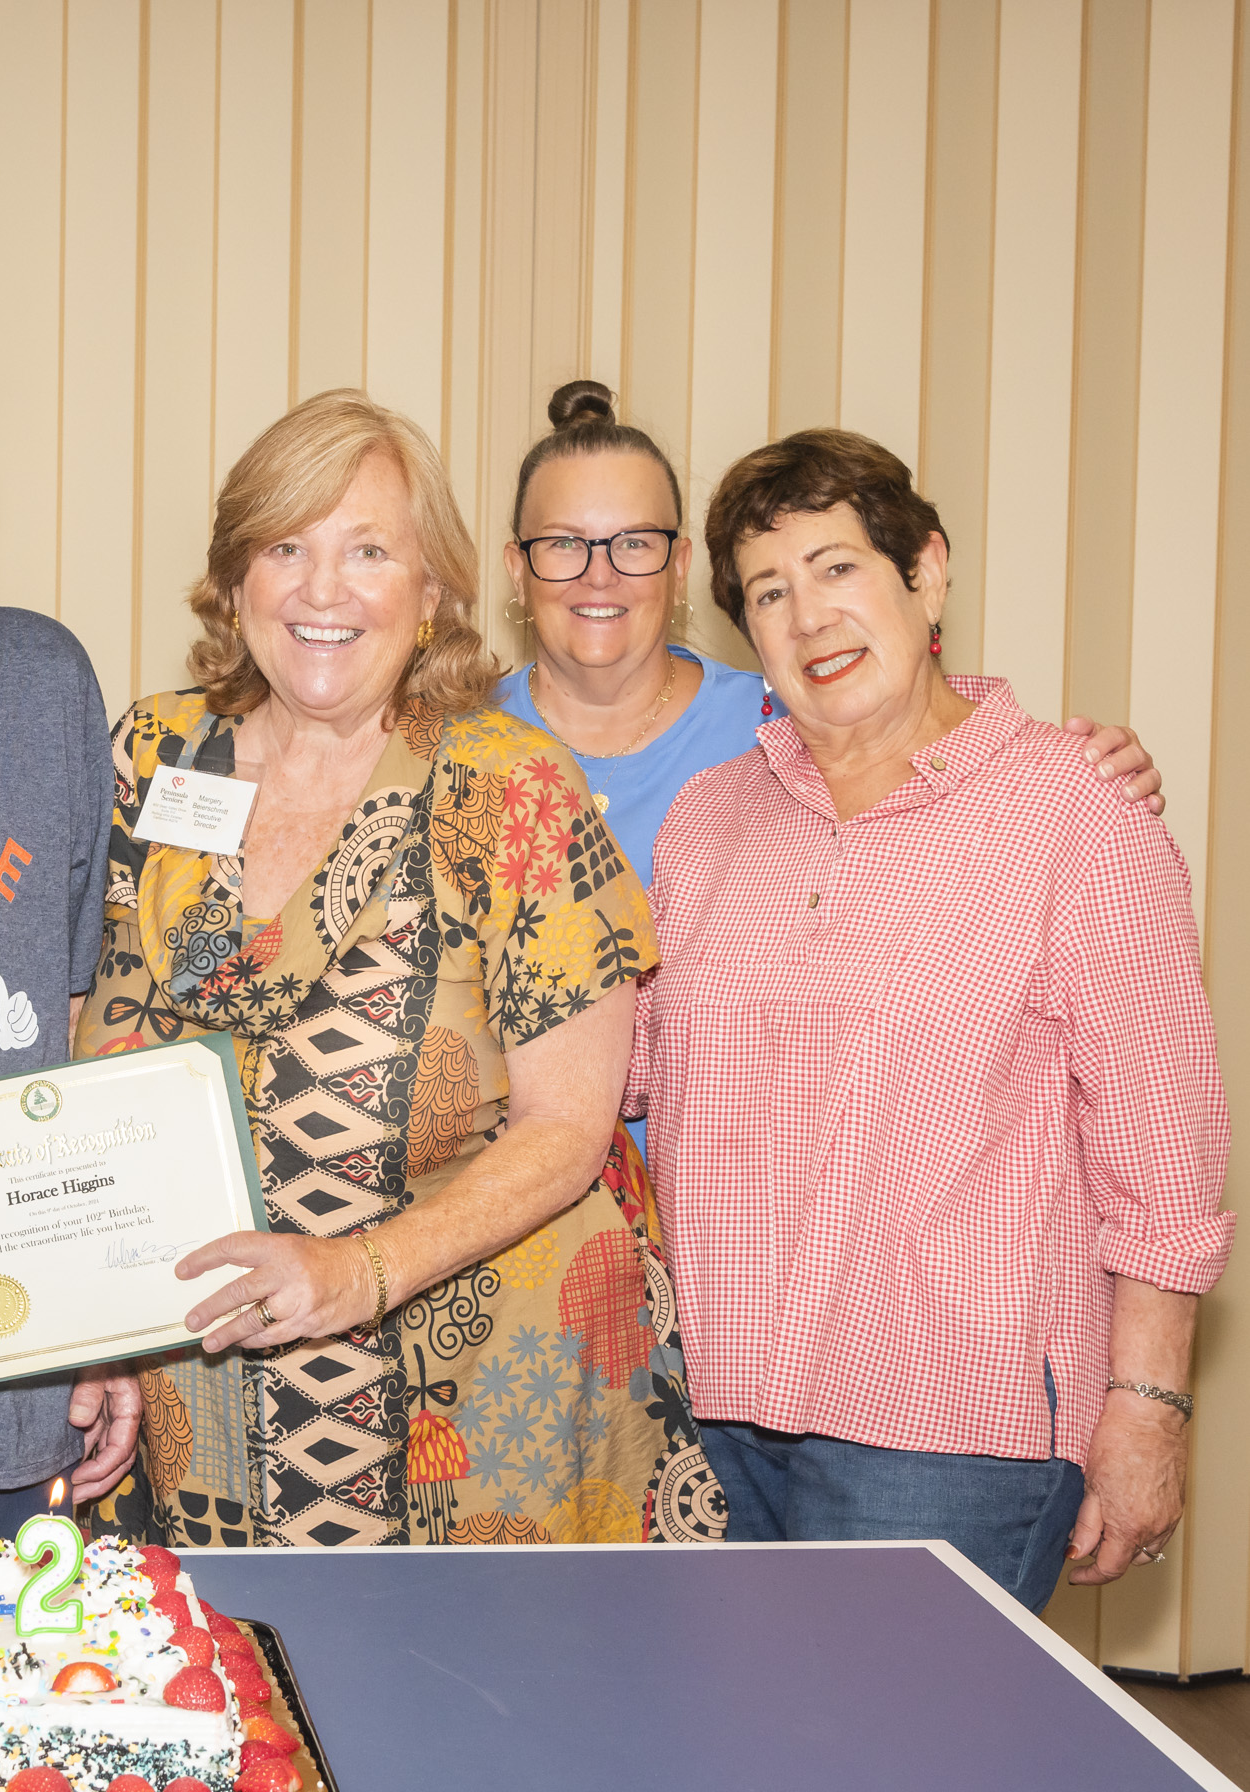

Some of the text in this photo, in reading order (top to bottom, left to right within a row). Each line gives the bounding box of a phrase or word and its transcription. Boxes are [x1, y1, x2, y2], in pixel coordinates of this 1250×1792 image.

[160, 788, 188, 799] Peninsula
[161, 795, 183, 804] Seniors
[199, 795, 223, 805] Margery
[192, 803, 228, 815] Beierschmitt
[193, 811, 221, 822] Executive
[193, 820, 217, 829] Director
[35, 1134, 53, 1164] of
[53, 1116, 157, 1157] Recognition
[8, 1160, 107, 1185] This certificate is presented to
[6, 1174, 115, 1206] Horace Higgins
[0, 1223, 51, 1240] recognition
[51, 1219, 62, 1230] of
[62, 1216, 83, 1231] your
[108, 1203, 150, 1220] Birthday,
[4, 1240, 19, 1253] the
[20, 1229, 79, 1250] extraordinary
[80, 1226, 95, 1238] life
[96, 1223, 113, 1237] you
[114, 1218, 136, 1231] have
[137, 1213, 155, 1226] led.
